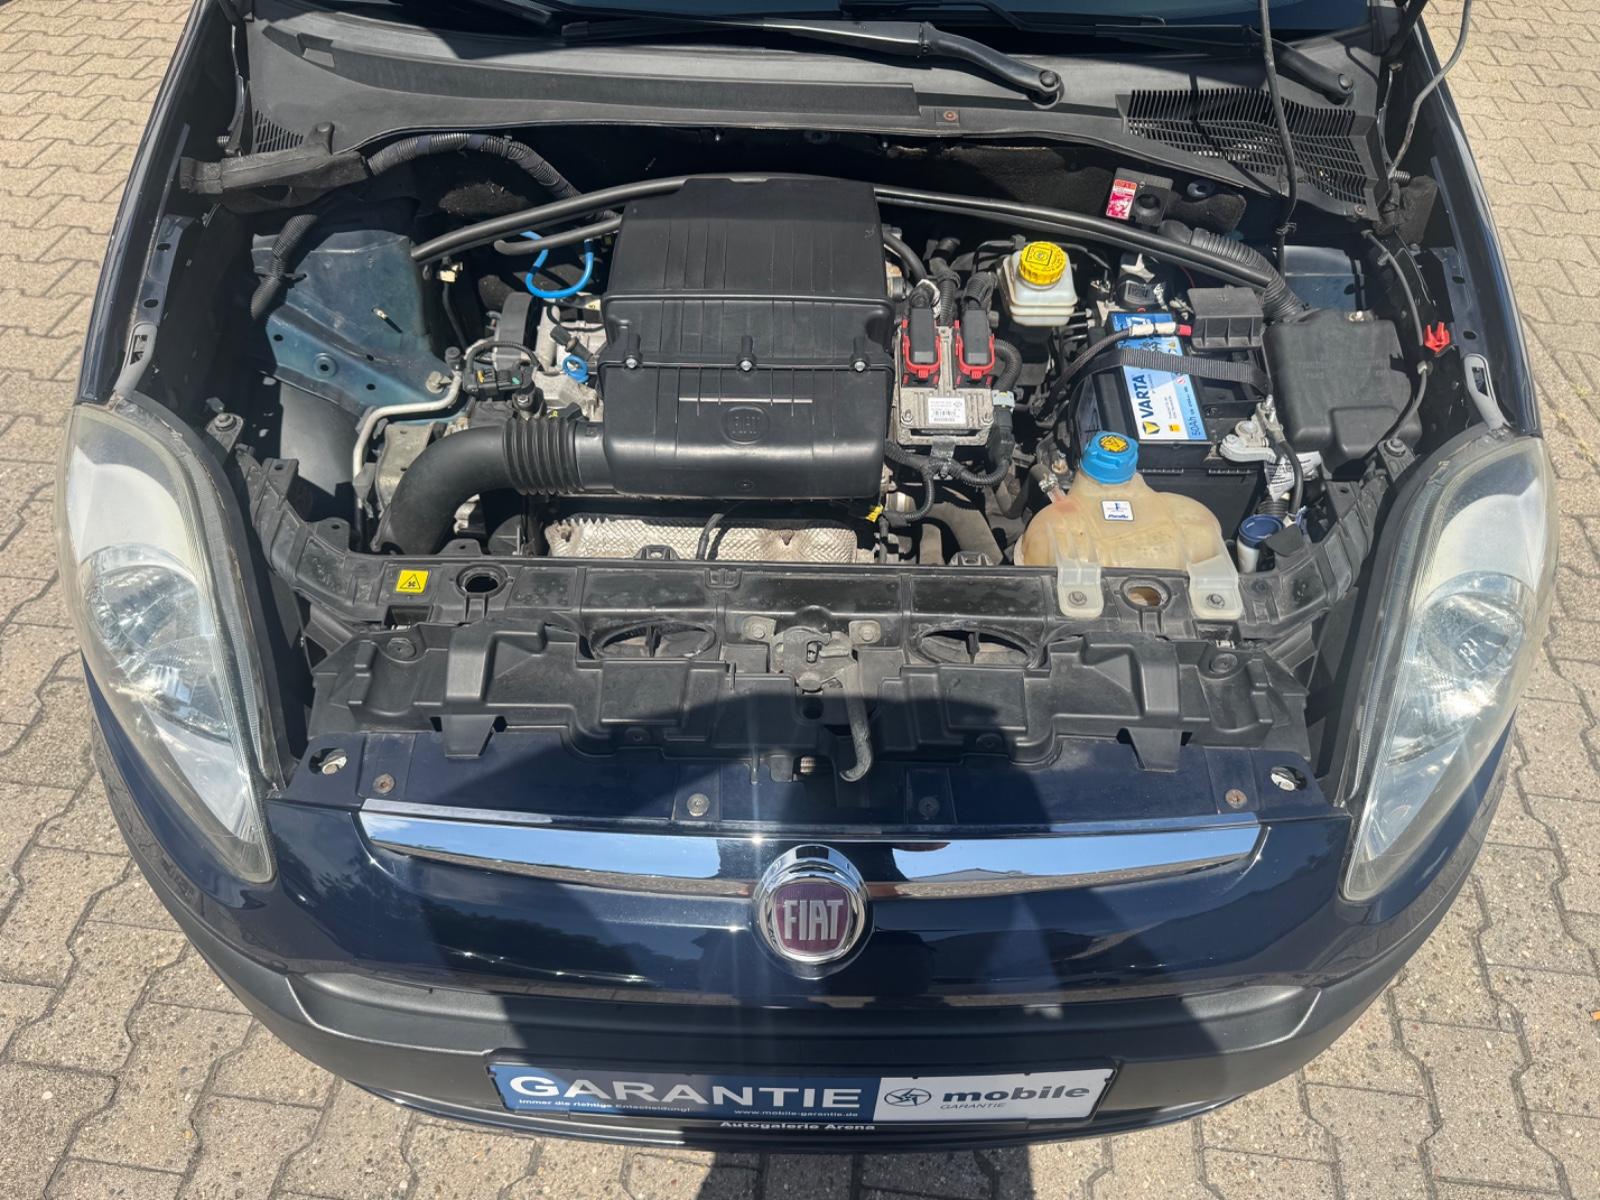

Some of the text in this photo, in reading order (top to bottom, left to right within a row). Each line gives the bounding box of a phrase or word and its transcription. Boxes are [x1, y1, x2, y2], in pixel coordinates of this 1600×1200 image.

[1132, 374, 1154, 419] VARTA
[783, 899, 844, 941] FIAT
[509, 1075, 862, 1108] GARANTIE
[942, 1085, 1090, 1103] mobile
[573, 1101, 613, 1109] richtige
[939, 1102, 1007, 1110] GARANTIE
[734, 1109, 859, 1118] www.mobile-garantie.de
[720, 1121, 876, 1131] Autogalerie Arena
